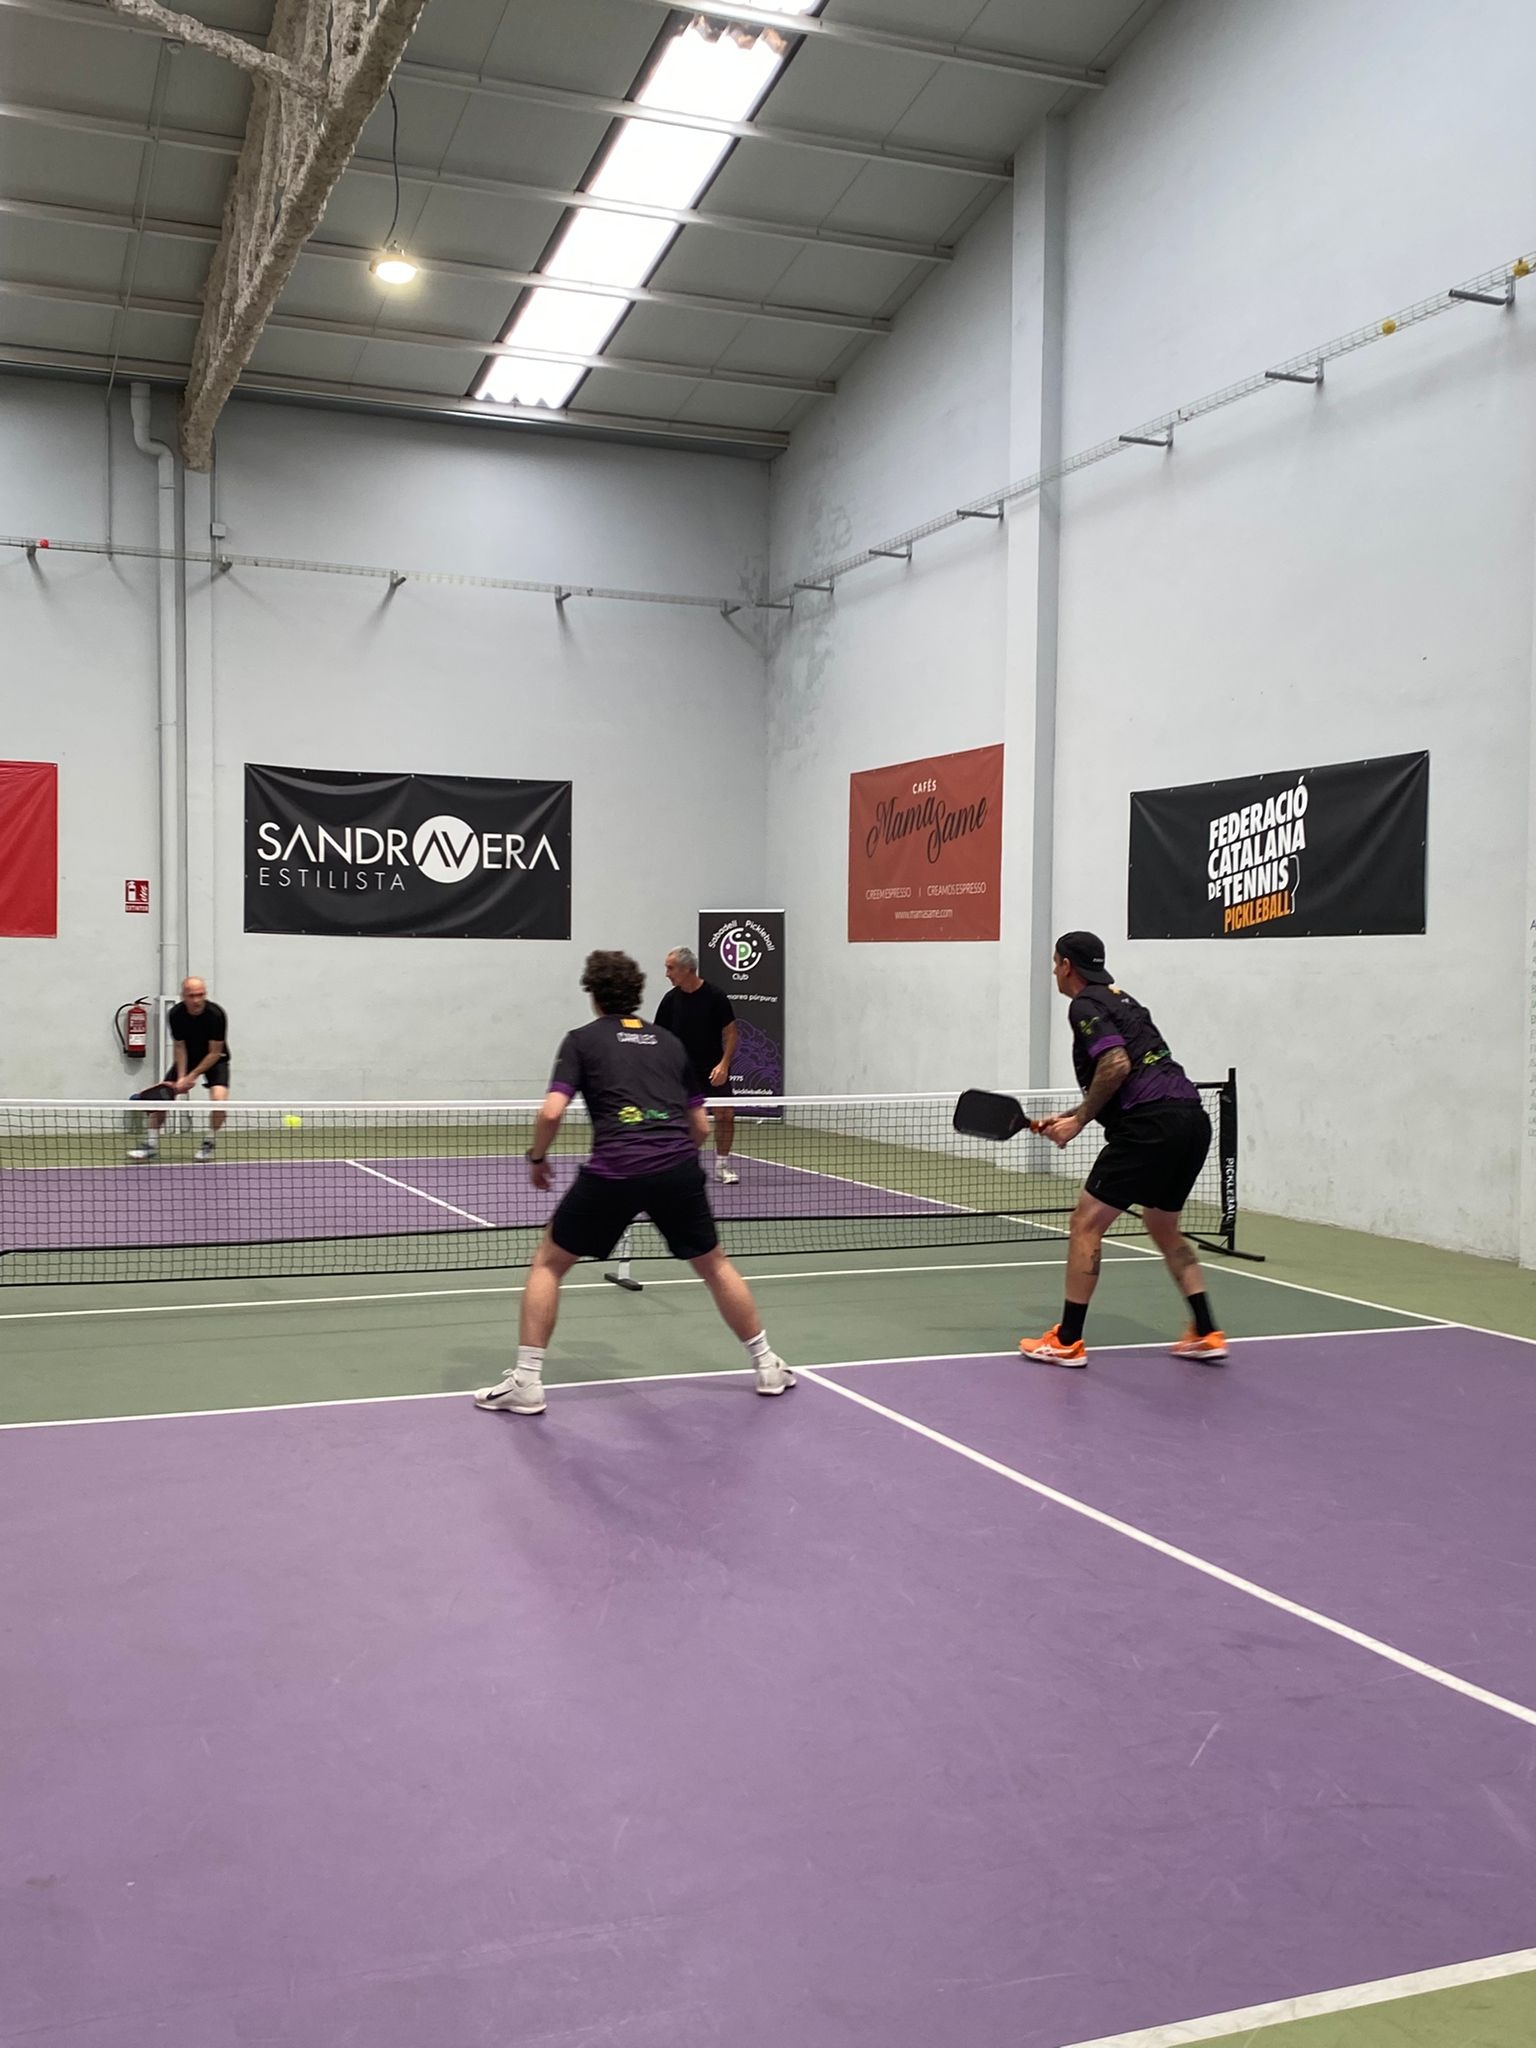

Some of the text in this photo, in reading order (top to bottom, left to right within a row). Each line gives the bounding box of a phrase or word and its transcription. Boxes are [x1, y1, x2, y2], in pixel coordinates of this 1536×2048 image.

[912, 778, 937, 795] CAFÉS
[866, 796, 936, 859] Mama
[1208, 775, 1308, 851] FEDERACIÓ
[1207, 818, 1306, 881] CATALANA
[258, 867, 406, 892] ESTILISTA
[1208, 857, 1290, 908] DE TENNIS
[1223, 889, 1291, 933] PICKLEBALL
[708, 919, 776, 952] Sabadell Pickleball
[731, 972, 750, 981] Club
